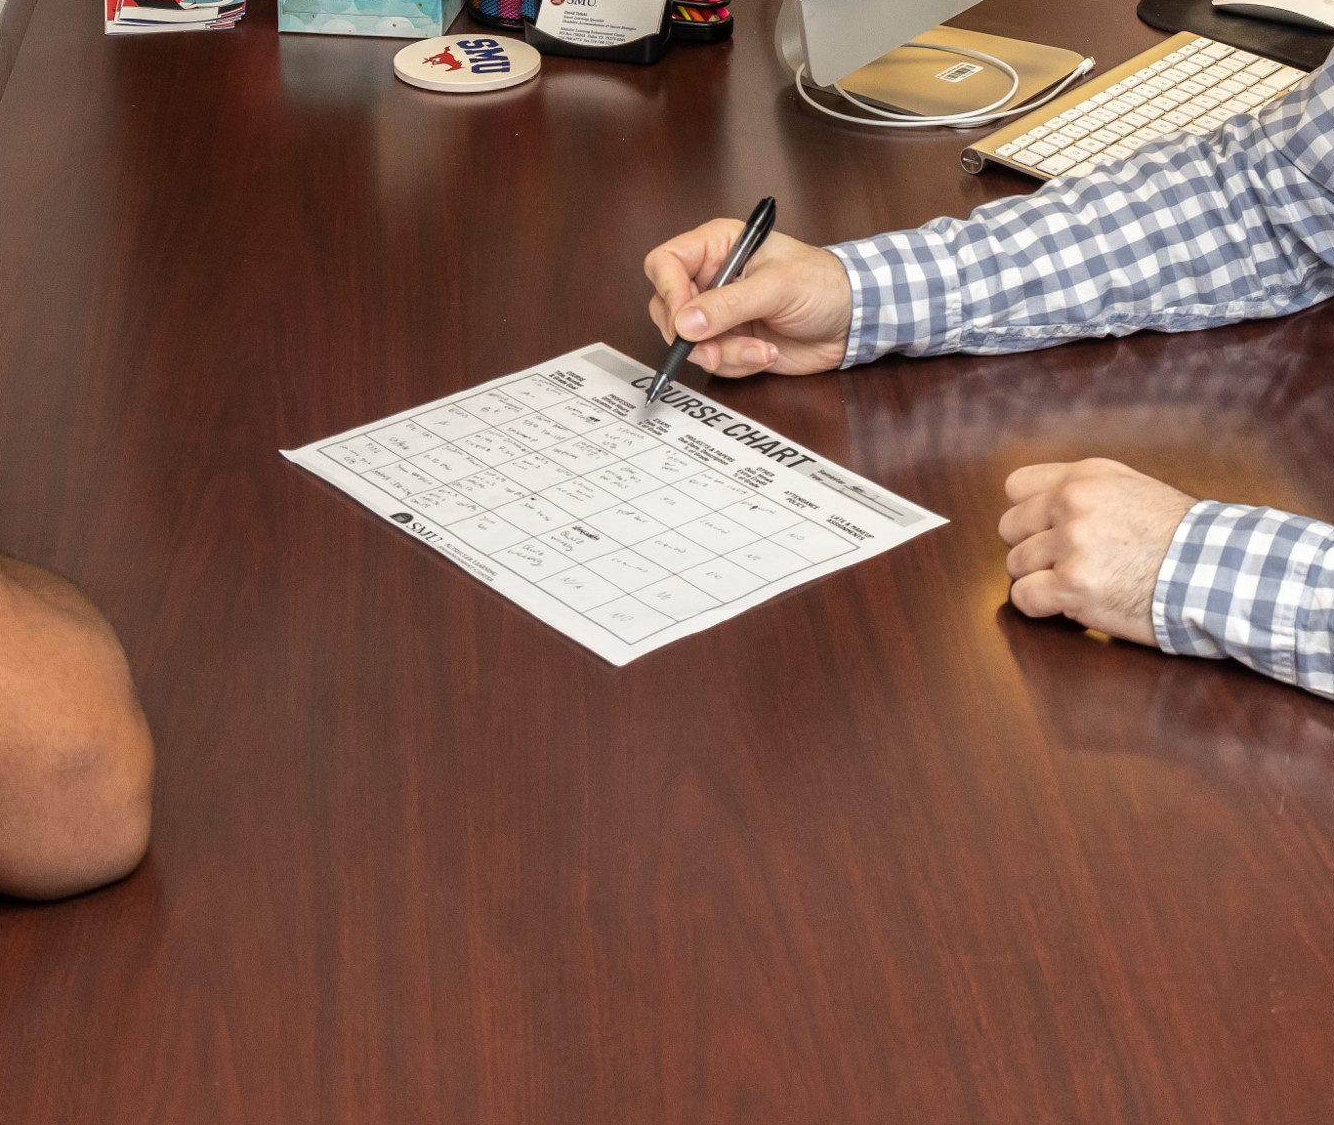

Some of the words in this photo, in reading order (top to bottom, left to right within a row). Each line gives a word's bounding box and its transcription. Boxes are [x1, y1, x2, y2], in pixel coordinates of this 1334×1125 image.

[456, 38, 511, 74] SMU
[565, 370, 587, 382] COURSE
[608, 393, 637, 410] PROFESSOR
[652, 418, 672, 429] EXAMS
[685, 434, 711, 449] PROJECTS
[716, 450, 736, 462] PAPERS
[722, 423, 817, 468] CHART
[756, 467, 776, 477] OTHER
[809, 473, 823, 483] Year
[817, 469, 845, 485] Semester
[783, 490, 821, 510] ATTENDANCE
[785, 497, 806, 509] POLICY
[409, 522, 443, 543] SMU
[826, 518, 866, 541] ASSIGNMENTS
[830, 514, 845, 524] LATE
[851, 525, 875, 539] MAKEUP
